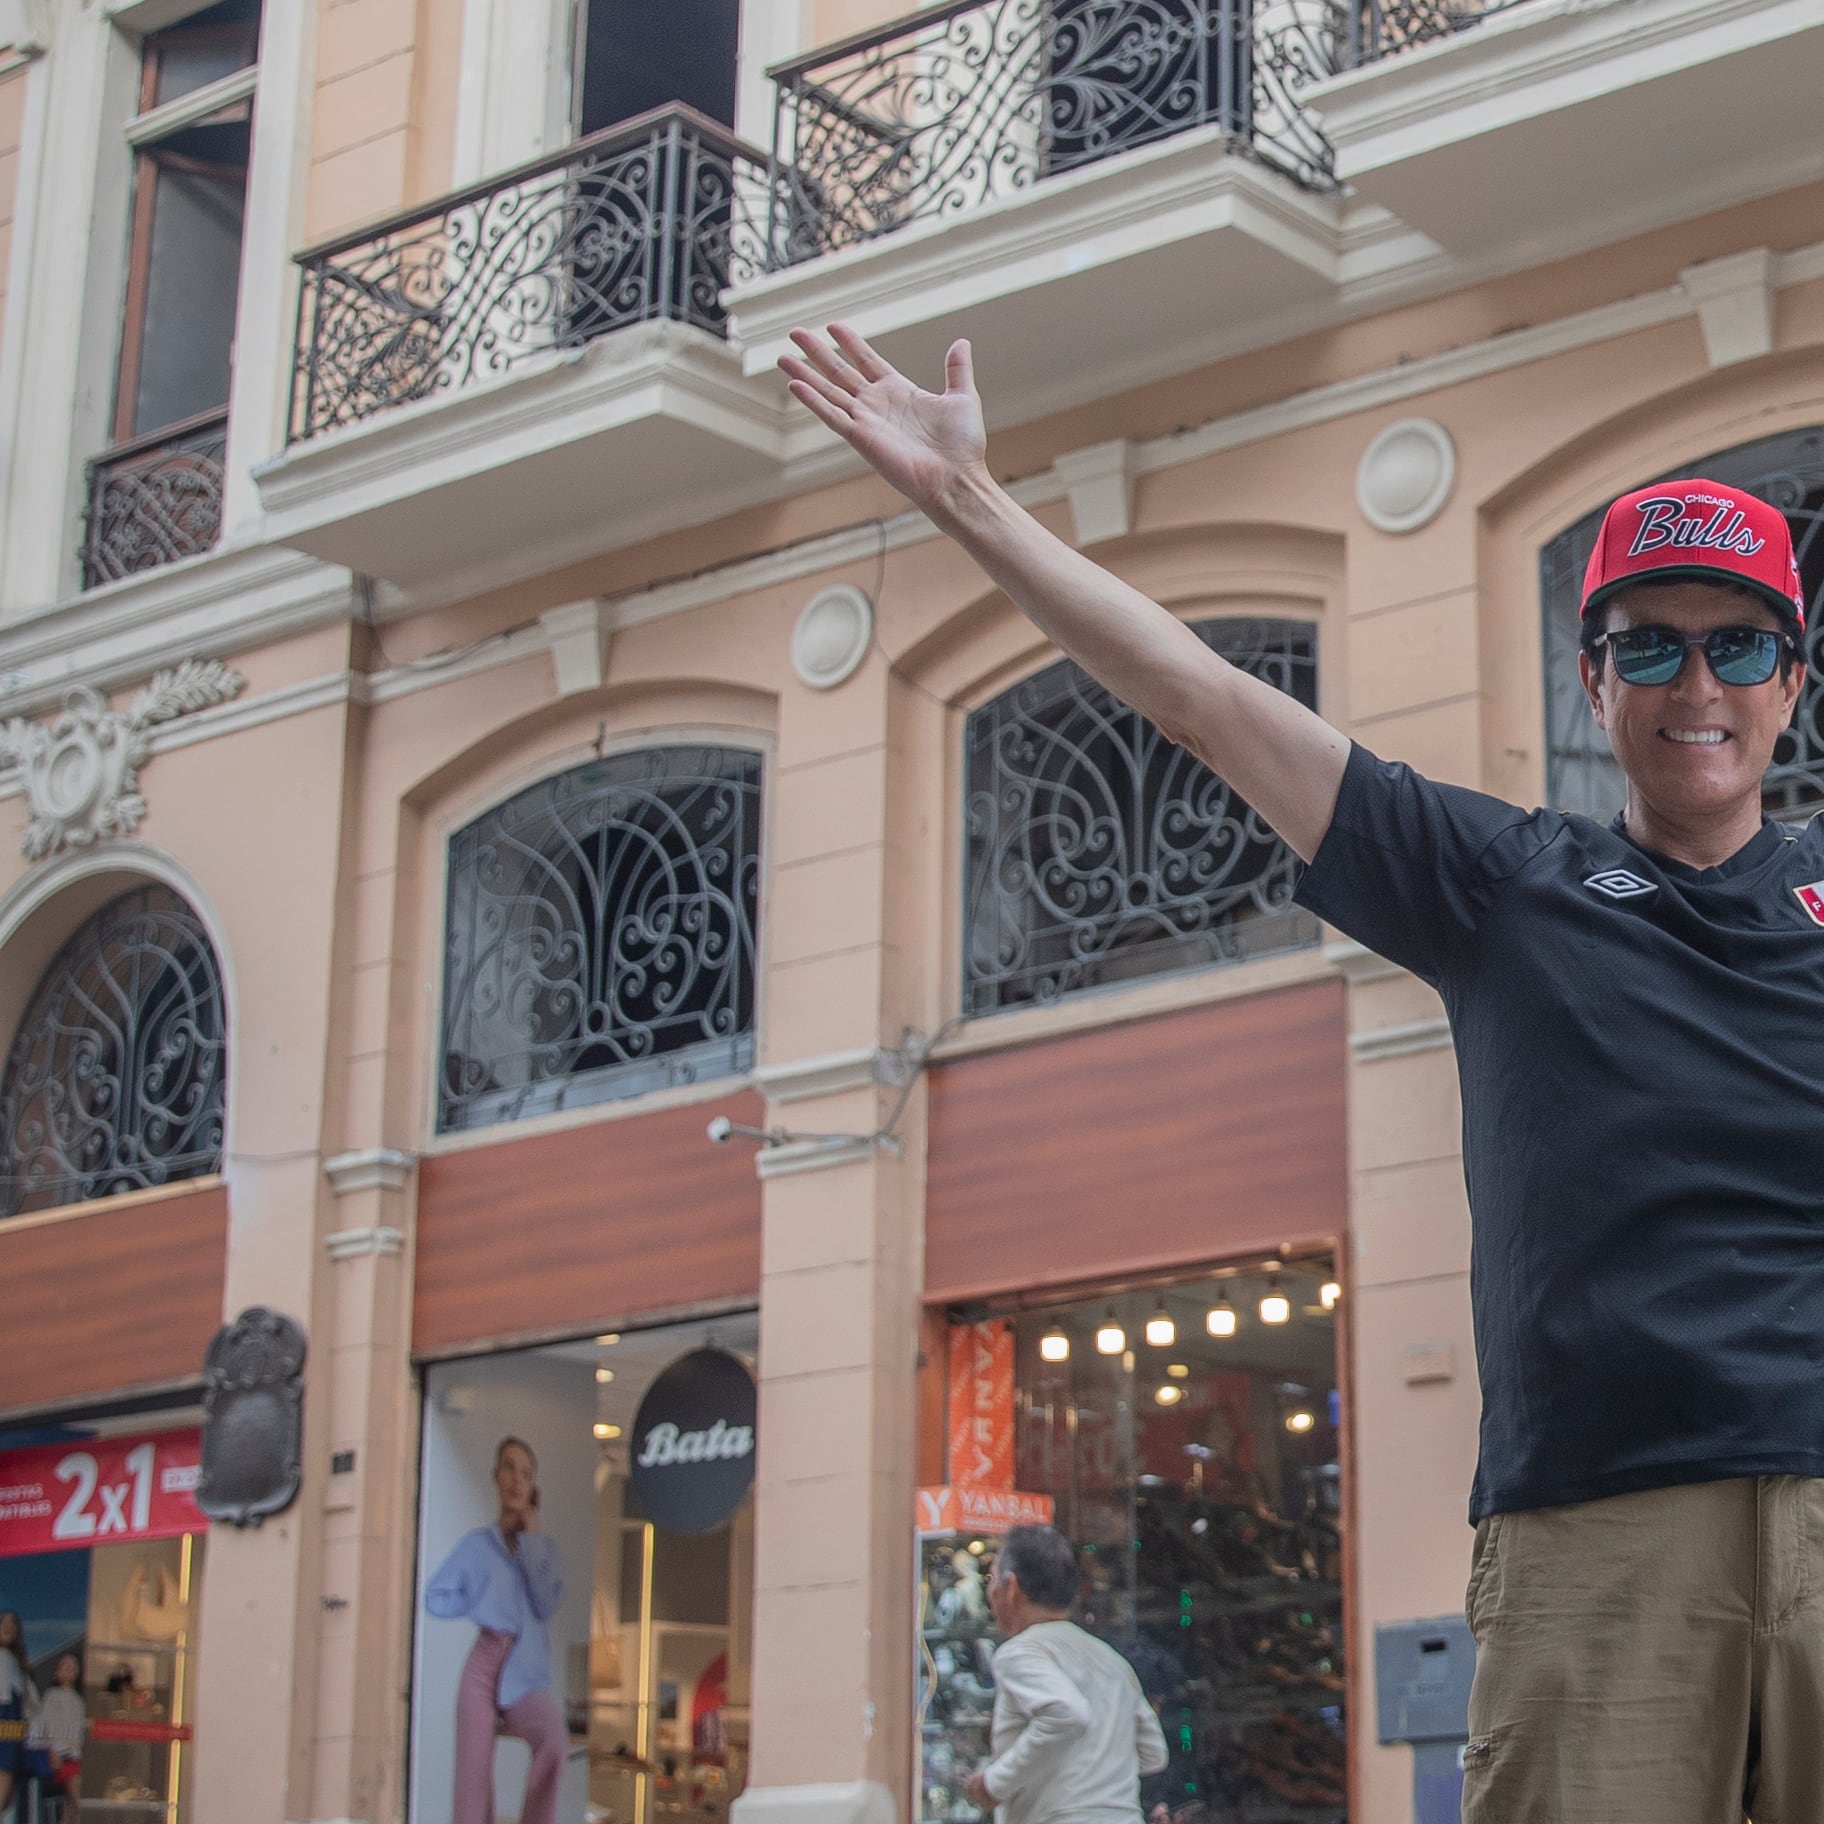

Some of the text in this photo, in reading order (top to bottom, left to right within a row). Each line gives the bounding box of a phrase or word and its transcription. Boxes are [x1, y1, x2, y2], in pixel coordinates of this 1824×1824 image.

[1627, 496, 1765, 557] Bulls
[1684, 493, 1735, 509] CHICAGO
[637, 1418, 755, 1469] Bata
[53, 1441, 157, 1540] 2x1
[920, 1488, 1047, 1528] Y YANBAL
